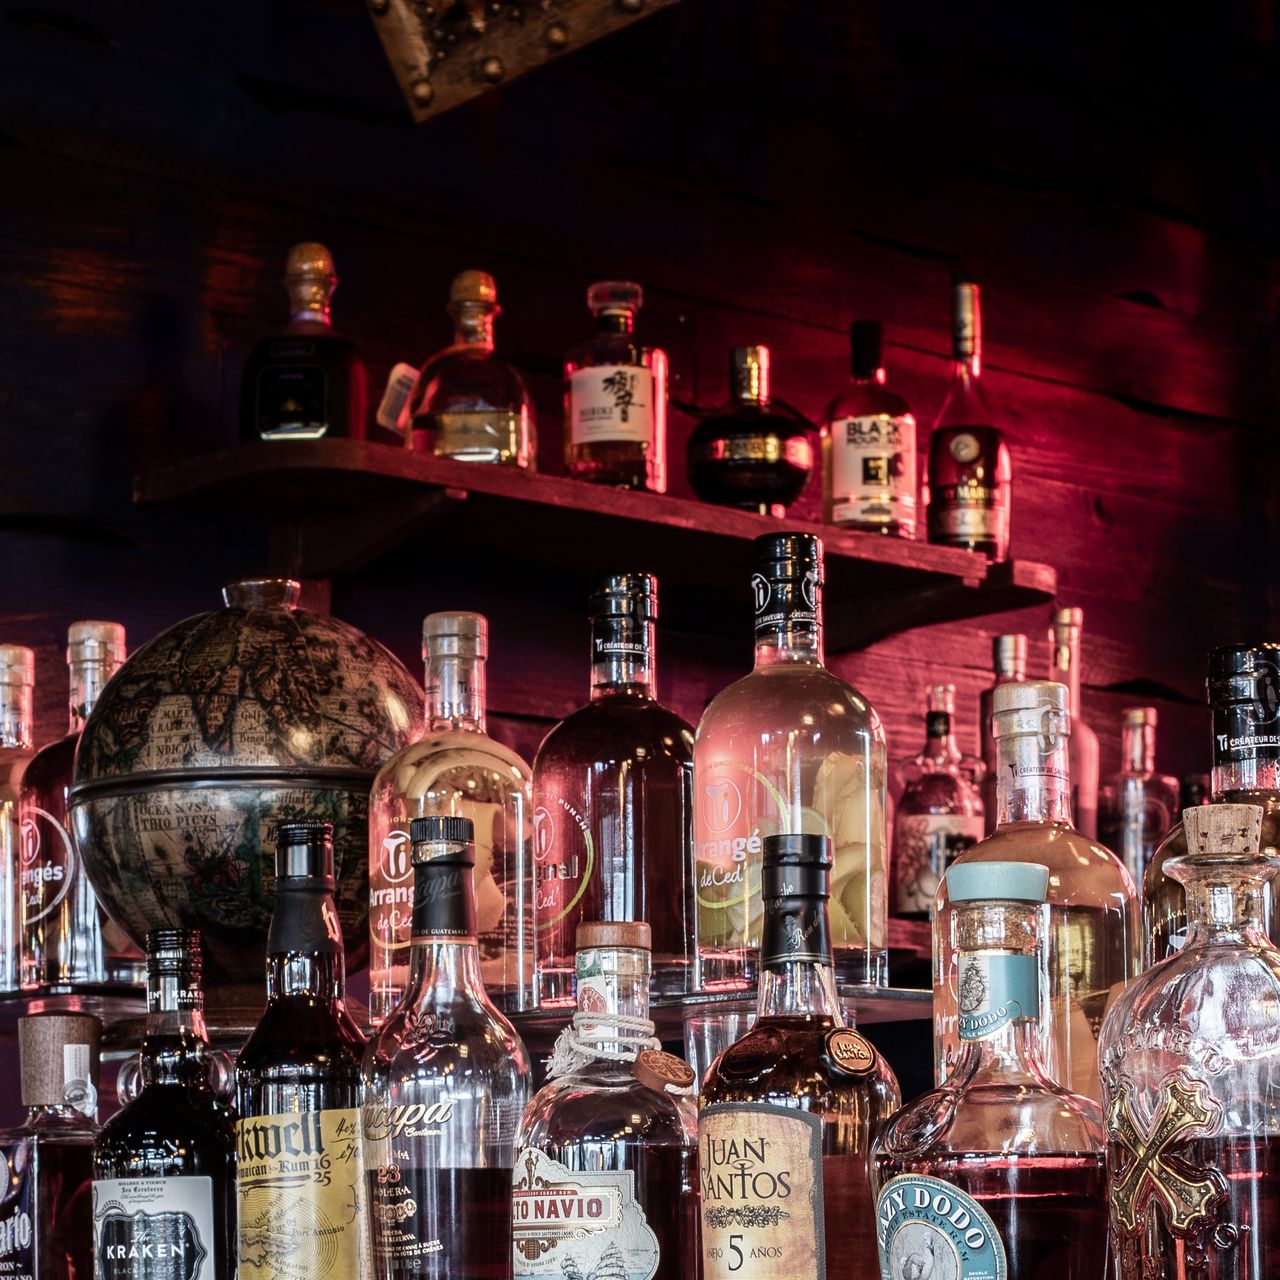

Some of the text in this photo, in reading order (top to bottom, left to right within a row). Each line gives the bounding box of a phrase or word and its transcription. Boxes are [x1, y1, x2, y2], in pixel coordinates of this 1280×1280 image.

[1229, 735, 1269, 747] CRÉATEUR
[558, 798, 587, 830] PUNCH
[970, 1006, 1008, 1031] DODO
[835, 1048, 870, 1060] SANTOS
[278, 1158, 310, 1173] Rum
[706, 1133, 766, 1179] JUAN
[313, 1171, 332, 1187] 25
[376, 1163, 402, 1184] 23
[701, 1162, 792, 1202] SANTOS
[534, 1198, 603, 1220] NAVIO
[902, 1209, 947, 1229] ESTATE
[913, 1186, 986, 1250] DODO
[106, 1243, 185, 1259] KRAKEN
[728, 1234, 783, 1272] 5 AÑOS
